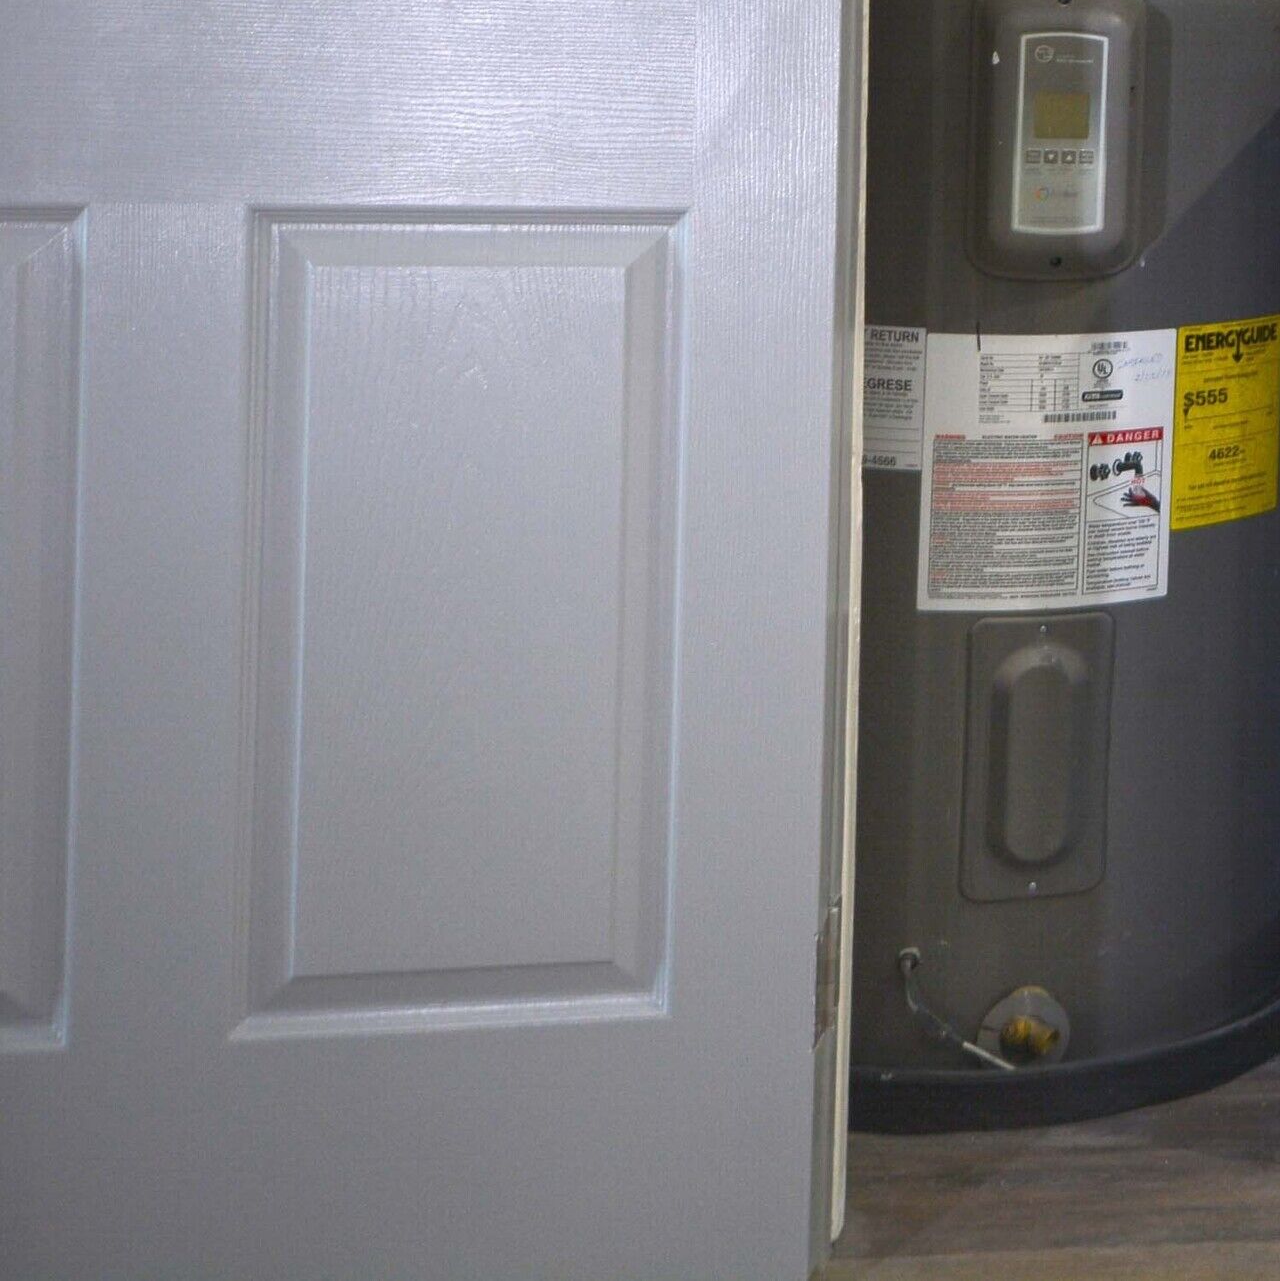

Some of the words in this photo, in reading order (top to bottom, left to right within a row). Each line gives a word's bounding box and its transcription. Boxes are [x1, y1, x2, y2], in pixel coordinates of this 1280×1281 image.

[871, 328, 919, 343] RETURN
[1185, 323, 1278, 353] ENERGYGUIDE
[1184, 387, 1228, 408] $555
[1107, 429, 1160, 443] DANGER
